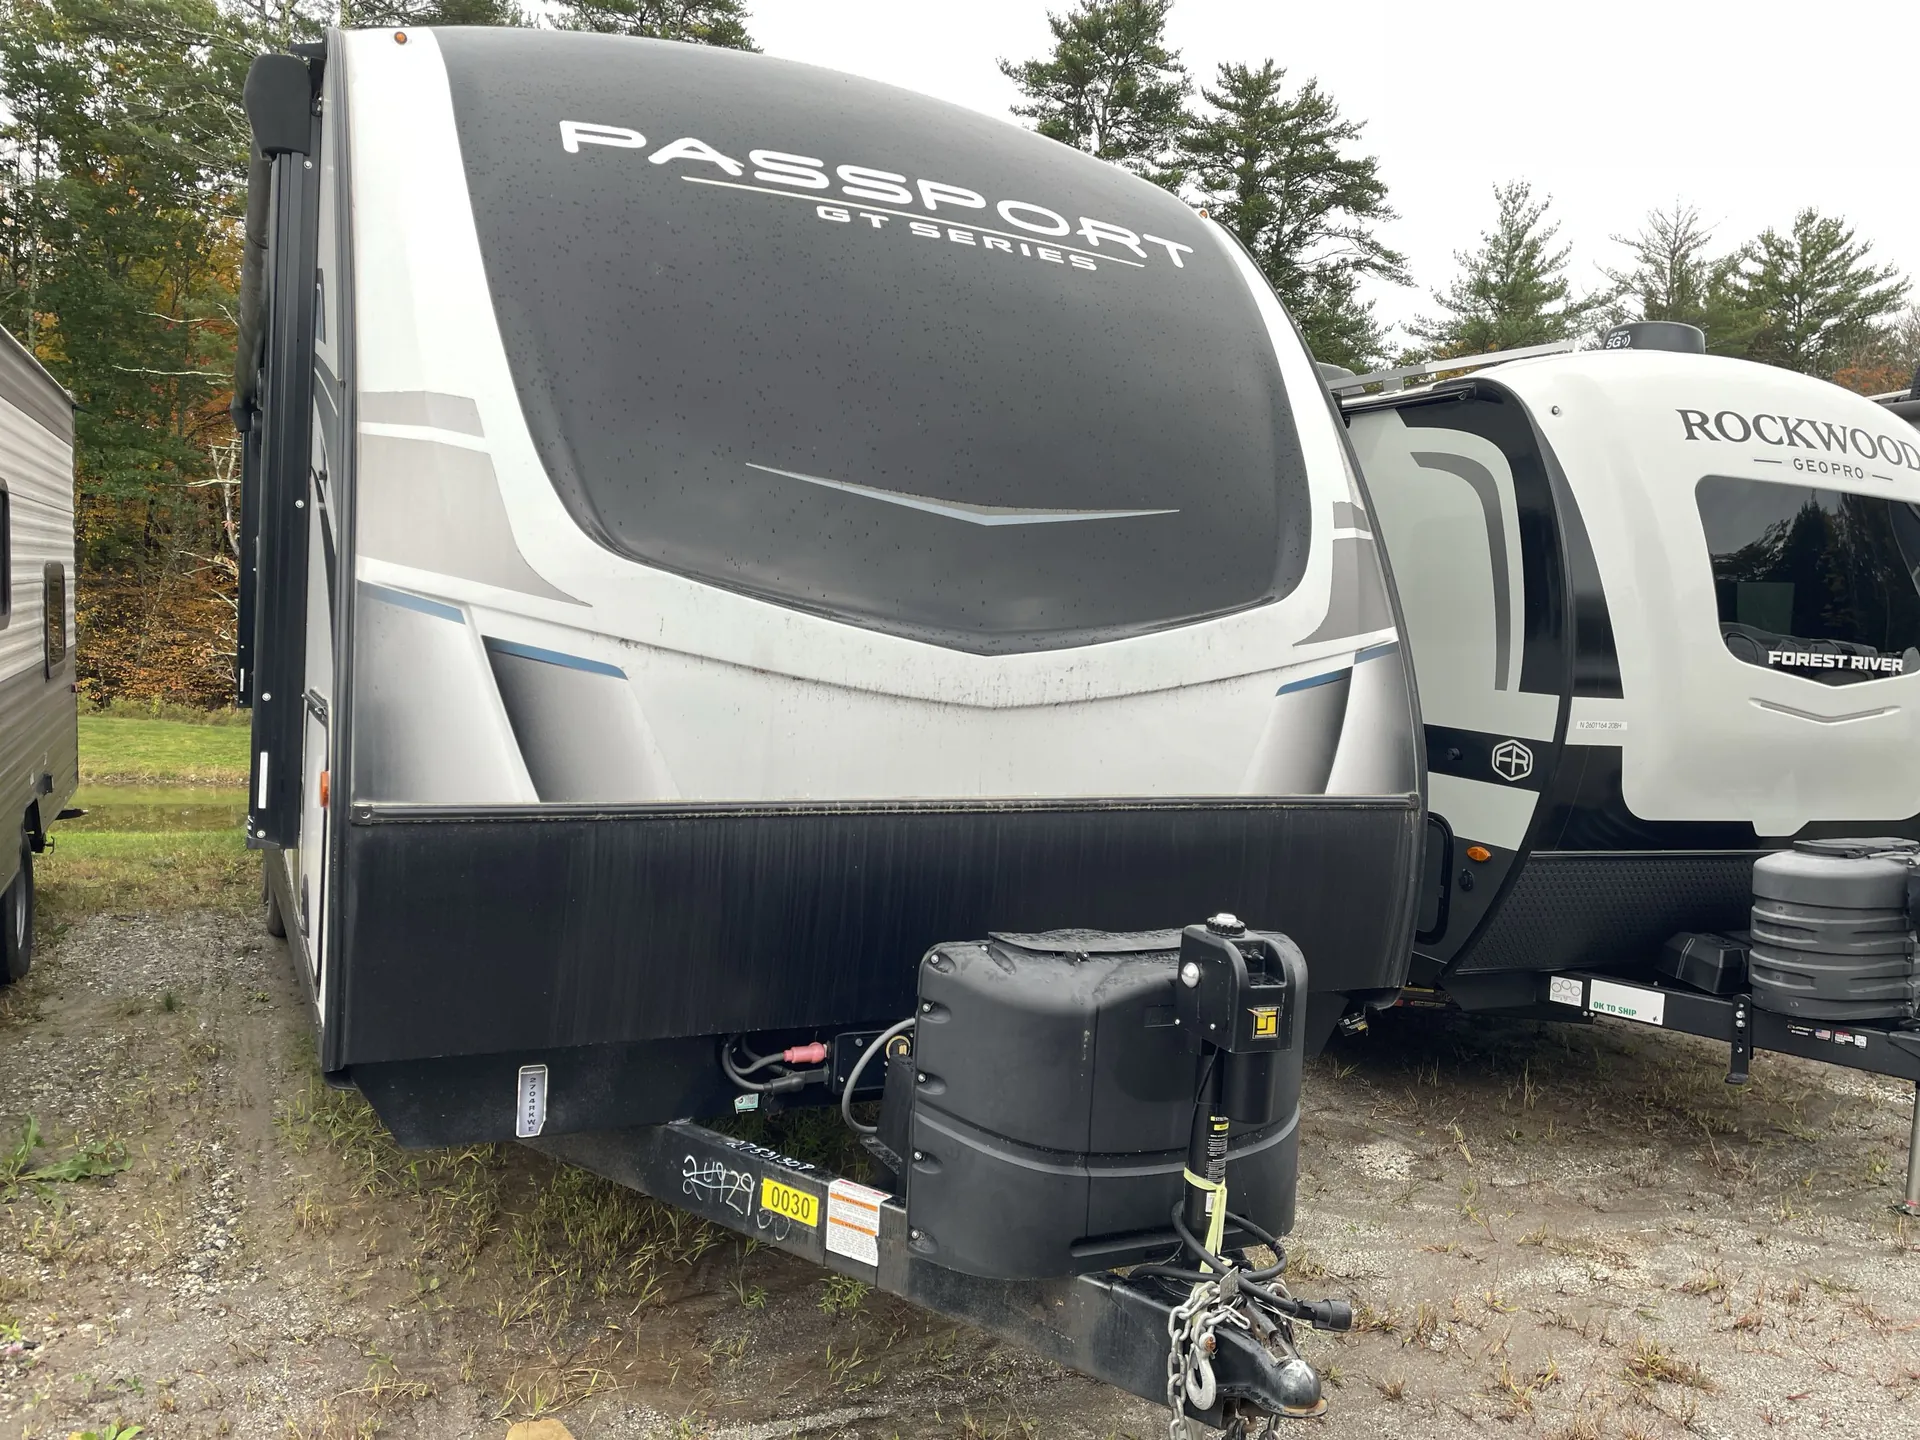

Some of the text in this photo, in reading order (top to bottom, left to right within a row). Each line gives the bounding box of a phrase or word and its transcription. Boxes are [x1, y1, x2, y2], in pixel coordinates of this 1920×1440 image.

[559, 120, 1194, 269] PASSPORT
[816, 205, 1097, 271] GT SERIES
[1606, 337, 1621, 348] 5G
[1675, 409, 1920, 472] ROCKWOOD
[1793, 458, 1864, 480] GEOPRO
[1768, 650, 1904, 672] FOREST RIVER
[1593, 1001, 1637, 1016] OK TO SHIP
[770, 1186, 811, 1220] 0030
